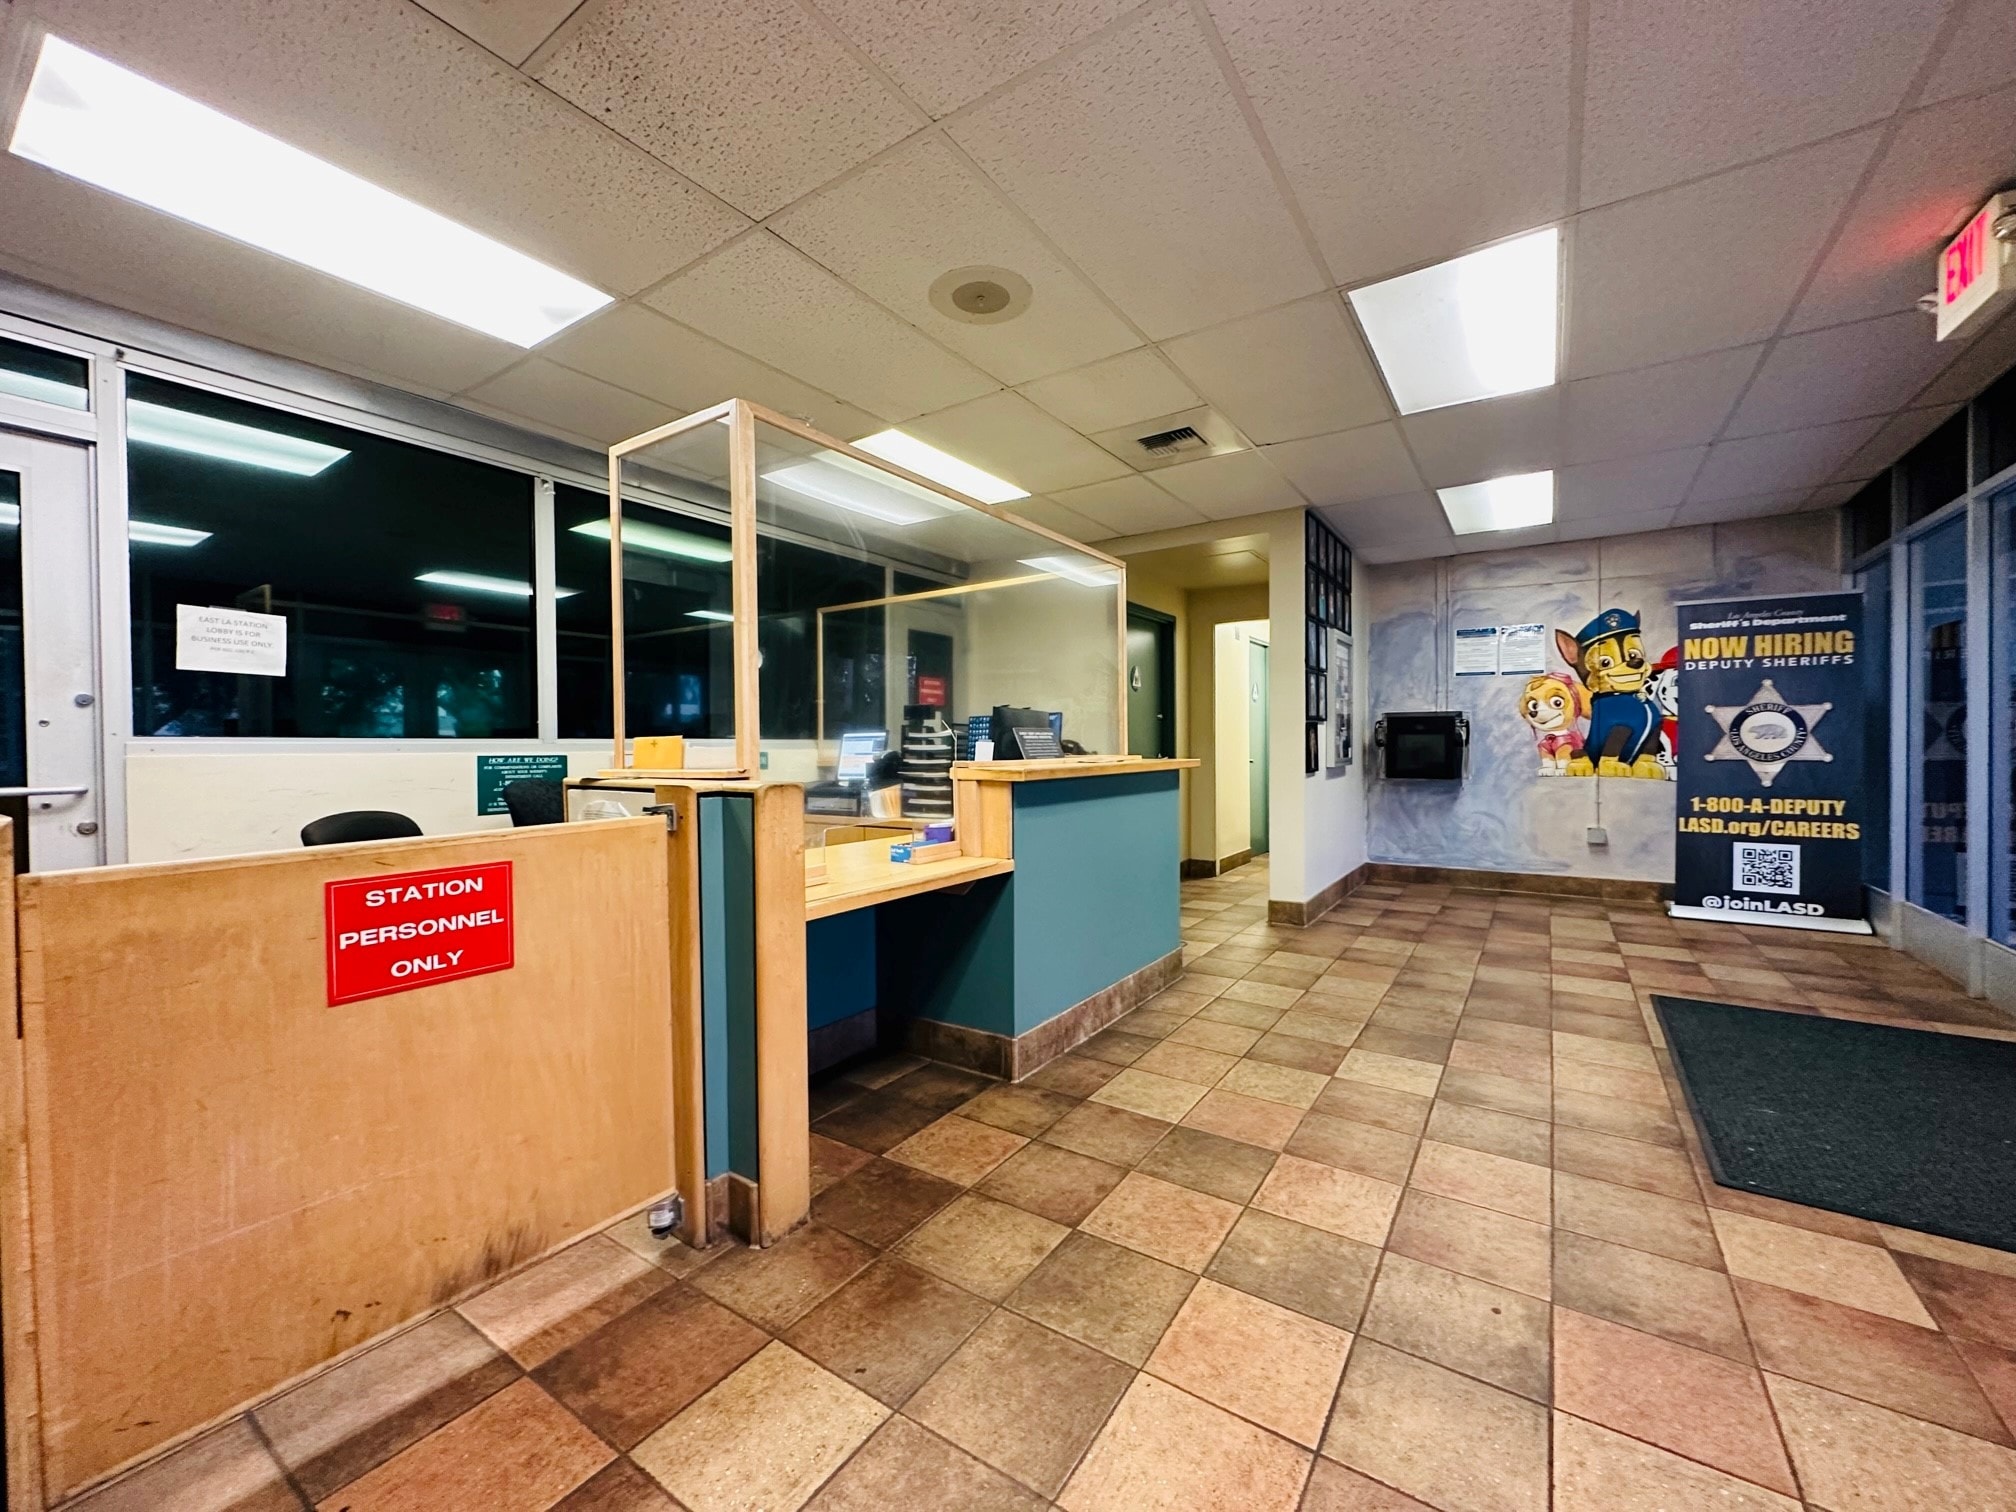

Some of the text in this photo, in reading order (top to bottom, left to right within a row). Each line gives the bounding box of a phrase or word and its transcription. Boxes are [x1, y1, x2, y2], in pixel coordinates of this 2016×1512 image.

[1945, 211, 1989, 304] EXIT
[199, 616, 219, 624] EAST
[234, 619, 268, 629] STATION
[206, 627, 233, 635] LOBBY
[1689, 614, 1847, 630] Sheriff's Department
[191, 635, 231, 645] BUSINESS
[233, 638, 249, 646] USE
[1684, 630, 1855, 660] NOW HIRING
[1685, 655, 1854, 671] DEPUTY SHERIFFS
[1745, 703, 1793, 714] SHERIFF
[1738, 746, 1780, 760] ANGELES
[1690, 797, 1846, 816] 1-800-A-DEPUTY
[1679, 817, 1860, 840] LASD.org/CAREERS
[365, 877, 483, 907] STATION
[1702, 895, 1825, 916] @joinLASD
[339, 909, 504, 950] PERSONNEL
[390, 950, 464, 977] ONLY
